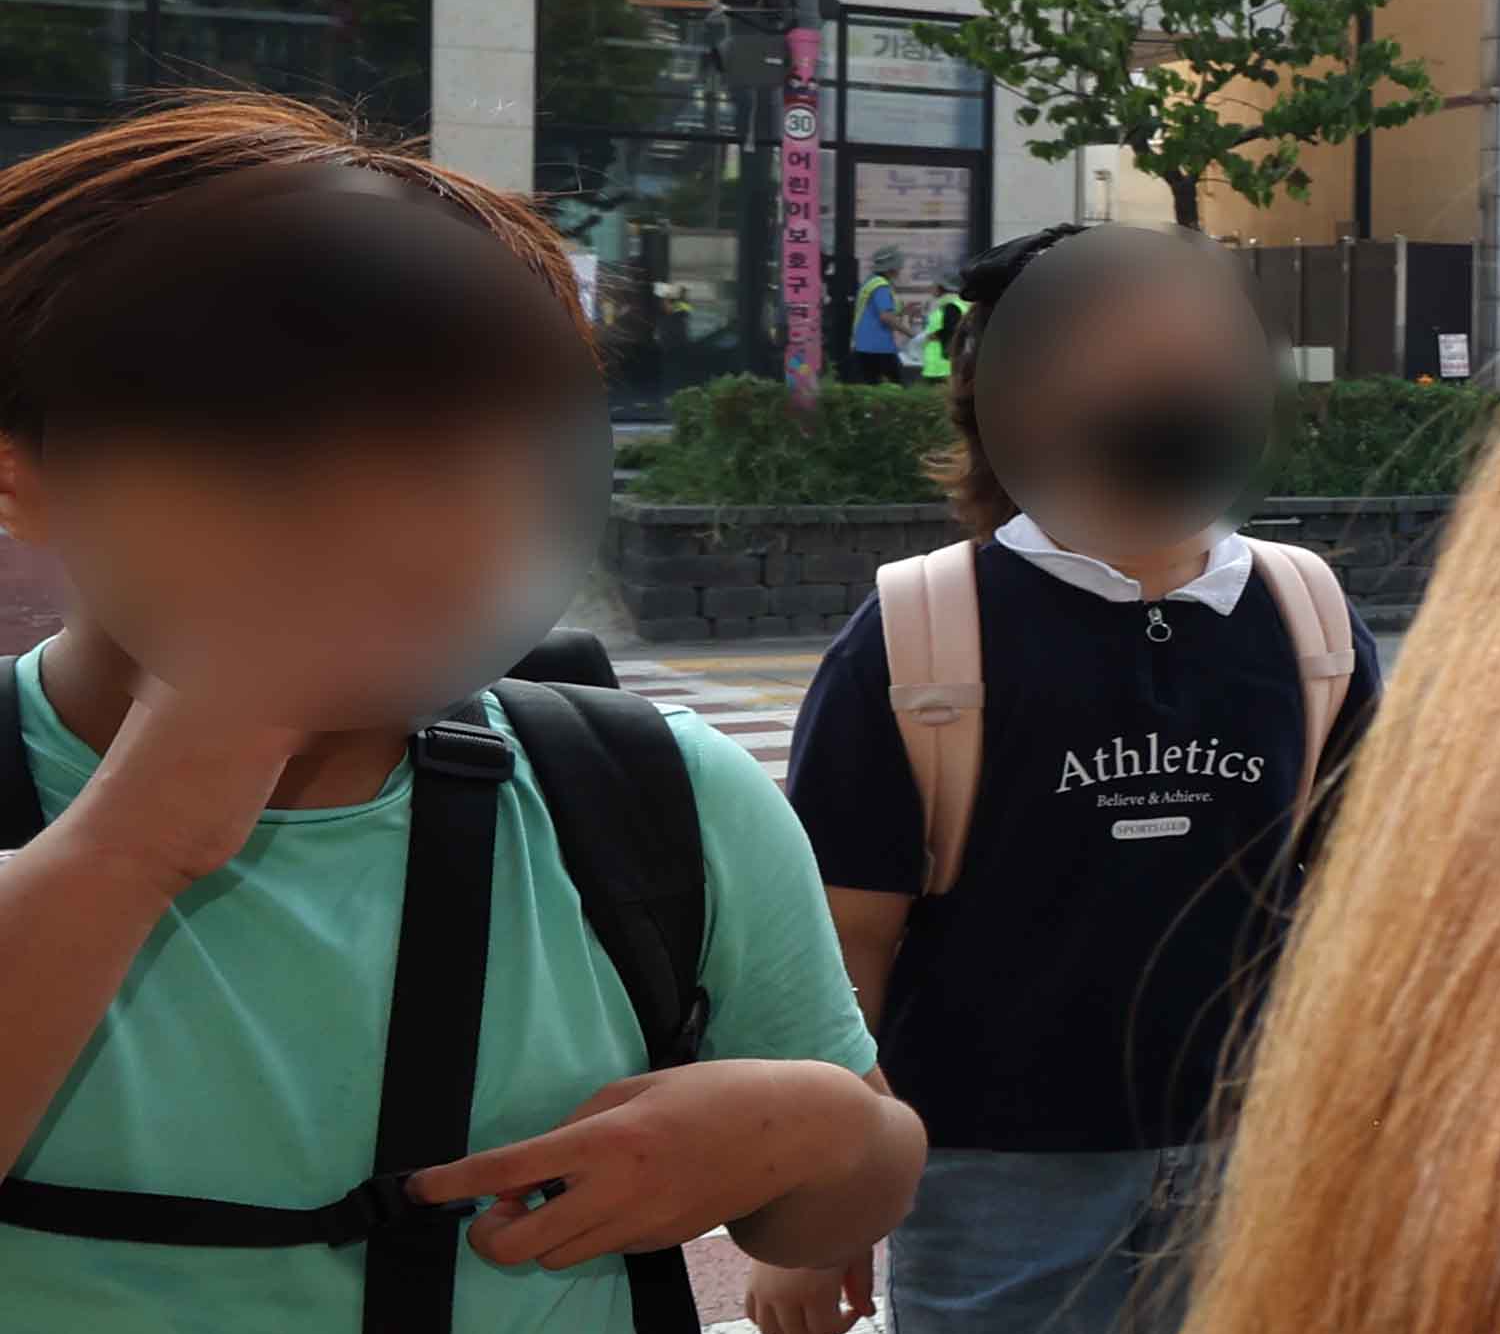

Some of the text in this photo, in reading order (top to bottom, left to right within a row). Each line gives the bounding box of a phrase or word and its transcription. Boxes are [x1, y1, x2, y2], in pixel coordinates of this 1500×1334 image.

[788, 114, 812, 133] 30
[1055, 733, 1264, 794] Athletics
[1097, 794, 1145, 808] Believe
[1162, 789, 1213, 805] Achieve.
